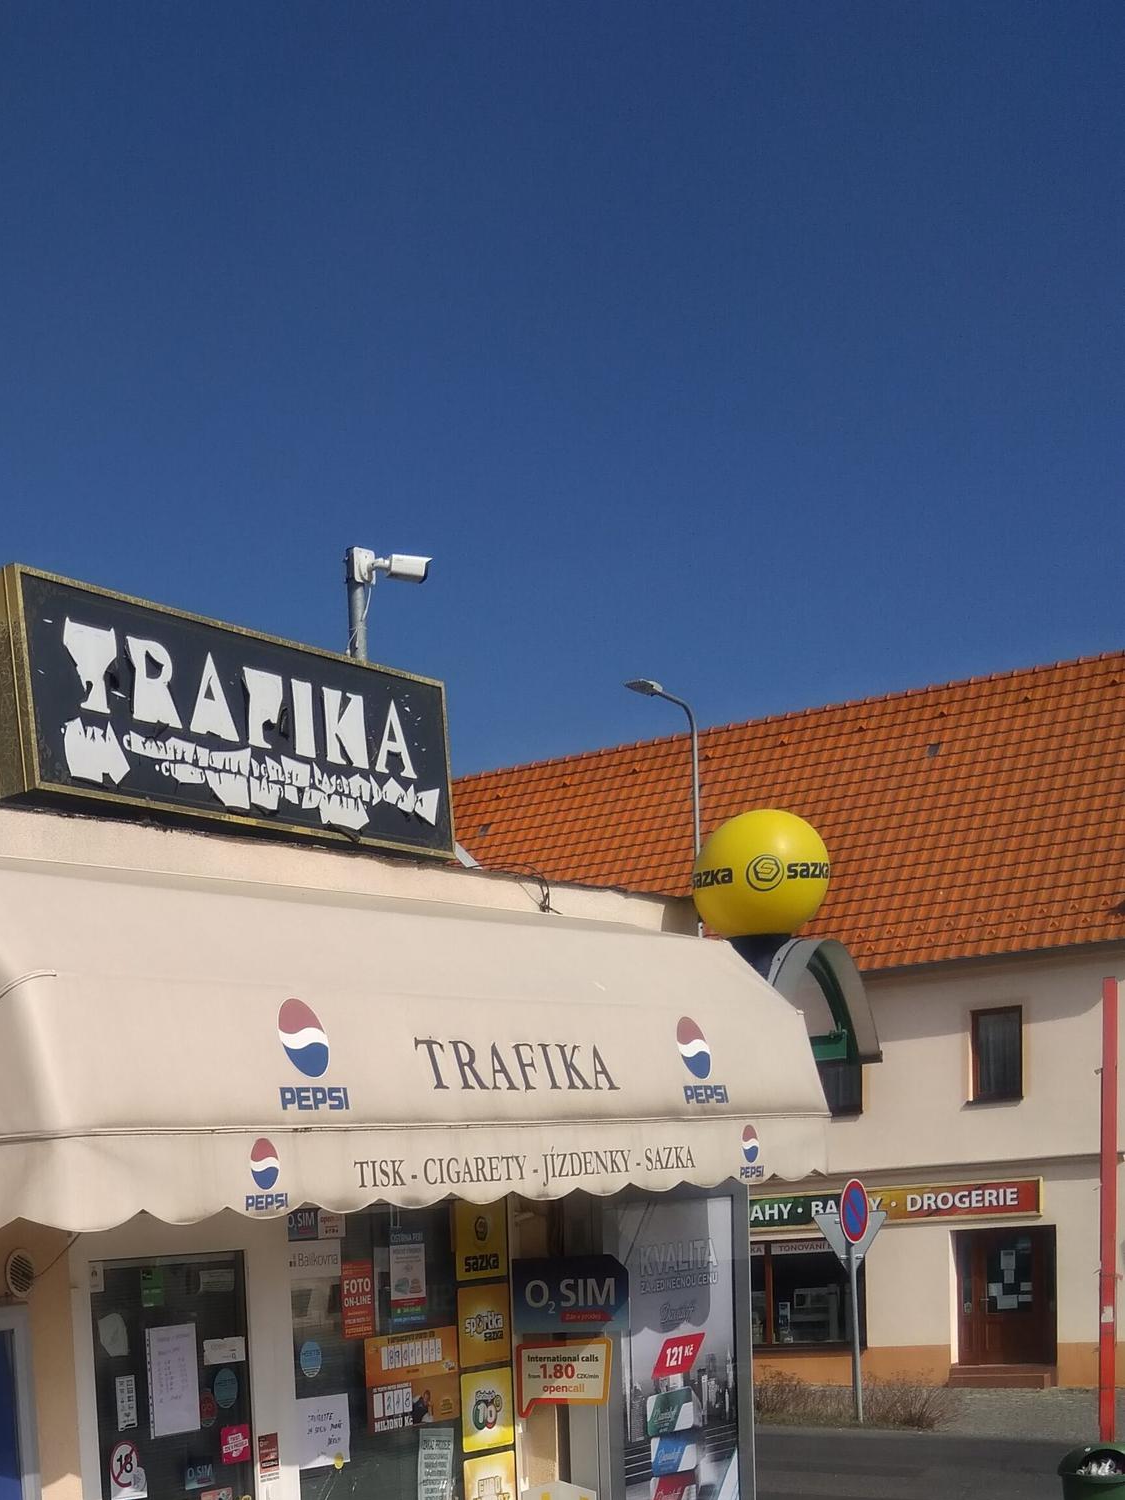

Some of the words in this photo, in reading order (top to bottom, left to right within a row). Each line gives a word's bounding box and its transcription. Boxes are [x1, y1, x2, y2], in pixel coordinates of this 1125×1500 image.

[414, 1036, 621, 1092] TRAFIKA
[279, 1086, 350, 1110] PEPSI
[683, 1084, 730, 1104] PEPSI
[354, 1158, 406, 1188] TISK
[423, 1155, 527, 1184] CIGARETY
[542, 1146, 631, 1186] JÍZDENKY
[644, 1145, 696, 1171] SAZKA
[740, 1165, 765, 1178] PEPSI
[245, 1194, 289, 1211] PEPSI
[906, 1187, 1019, 1211] DROGERIE
[297, 1212, 315, 1227] SIM
[639, 1239, 718, 1277] KVALITA
[343, 1278, 372, 1295] FOTO
[697, 1271, 718, 1286] CENU
[560, 1277, 616, 1307] SIM
[344, 1295, 372, 1308] ON-LINE
[464, 1310, 504, 1337] sportka
[580, 1354, 599, 1362] calls
[666, 1345, 683, 1367] 121
[539, 1363, 576, 1380] 1.80
[542, 1383, 585, 1394] opencall
[116, 1454, 133, 1473] 18
[197, 1463, 213, 1478] SIM
